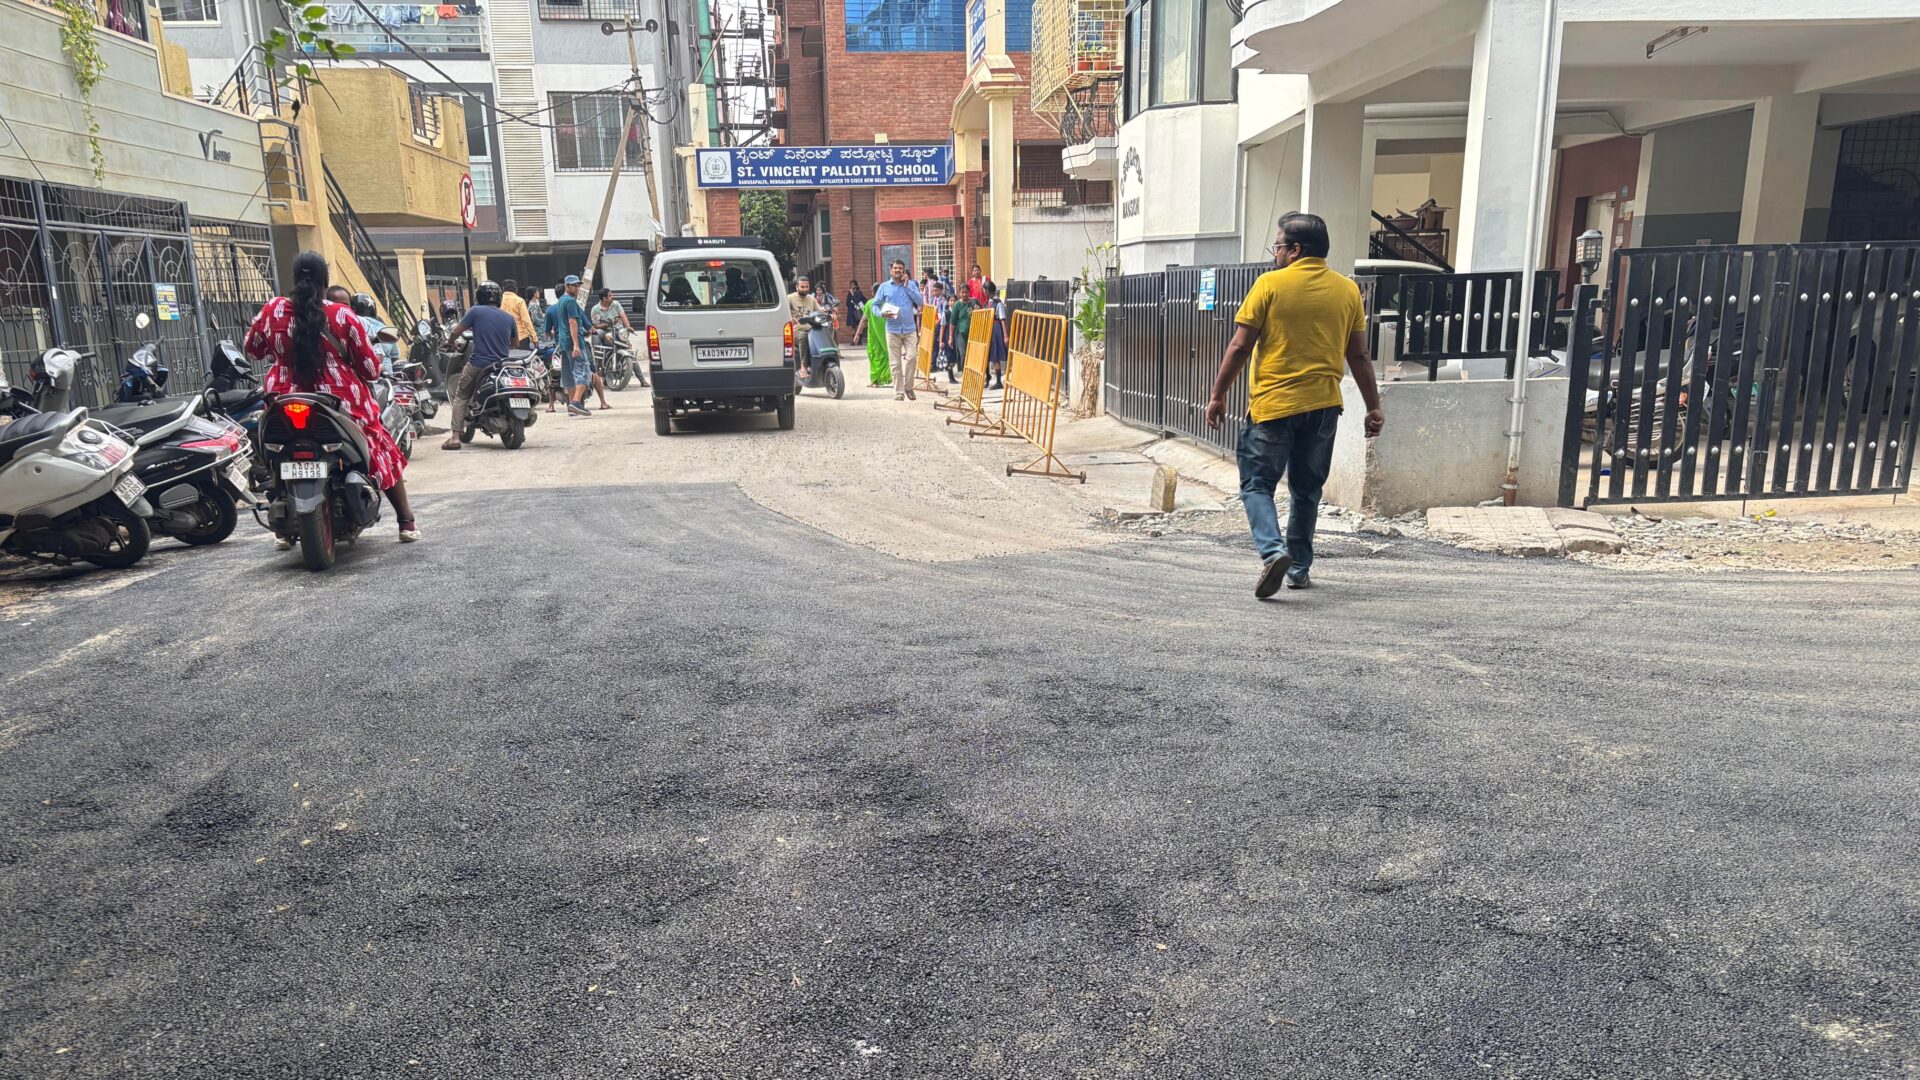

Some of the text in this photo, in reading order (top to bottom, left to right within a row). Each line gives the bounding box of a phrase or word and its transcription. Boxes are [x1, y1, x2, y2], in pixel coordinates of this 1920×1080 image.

[737, 164, 939, 177] ST. VINCENT PALLOTTI SCHOOL
